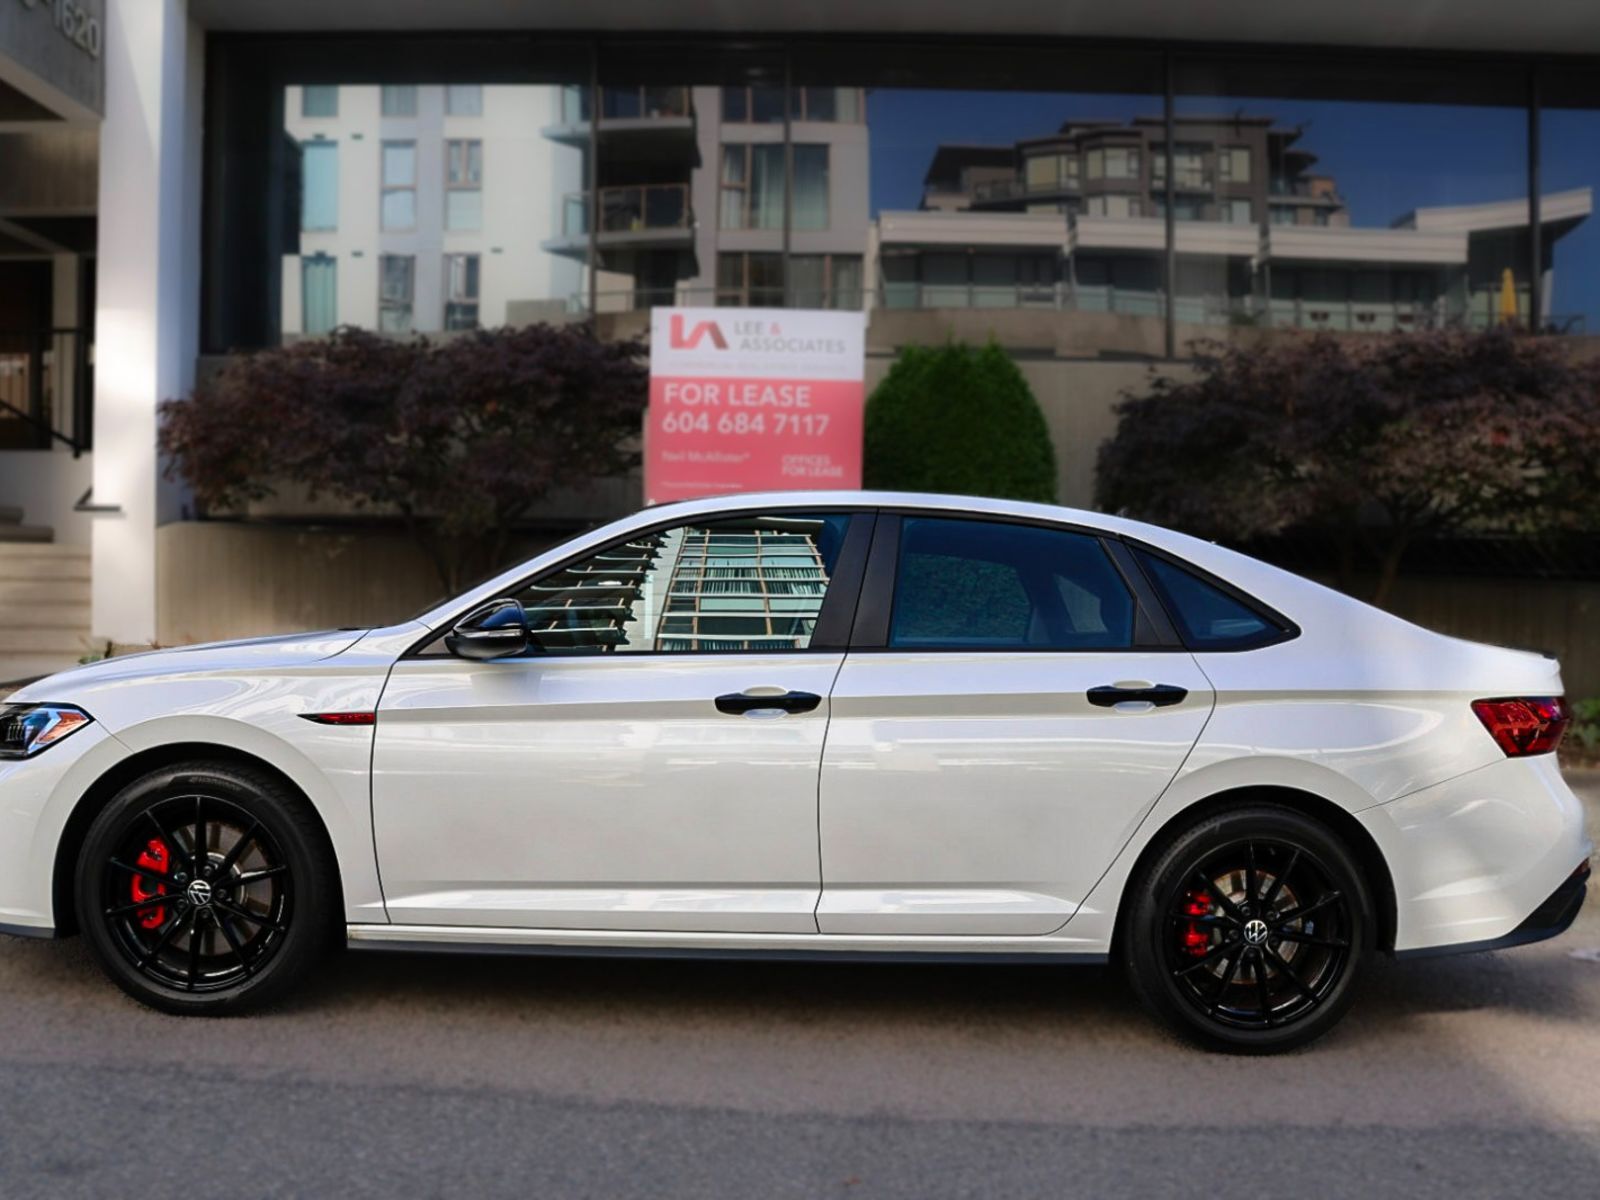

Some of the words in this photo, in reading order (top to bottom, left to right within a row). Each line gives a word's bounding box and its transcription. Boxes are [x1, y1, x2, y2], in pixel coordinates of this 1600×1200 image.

[733, 320, 764, 336] LEE
[769, 321, 782, 336] &
[739, 337, 847, 354] ASSOCIATES
[664, 383, 720, 405] FOR
[728, 385, 812, 408] LEASE
[661, 411, 709, 433] 604
[717, 412, 765, 434] 684
[773, 413, 830, 436] 7117
